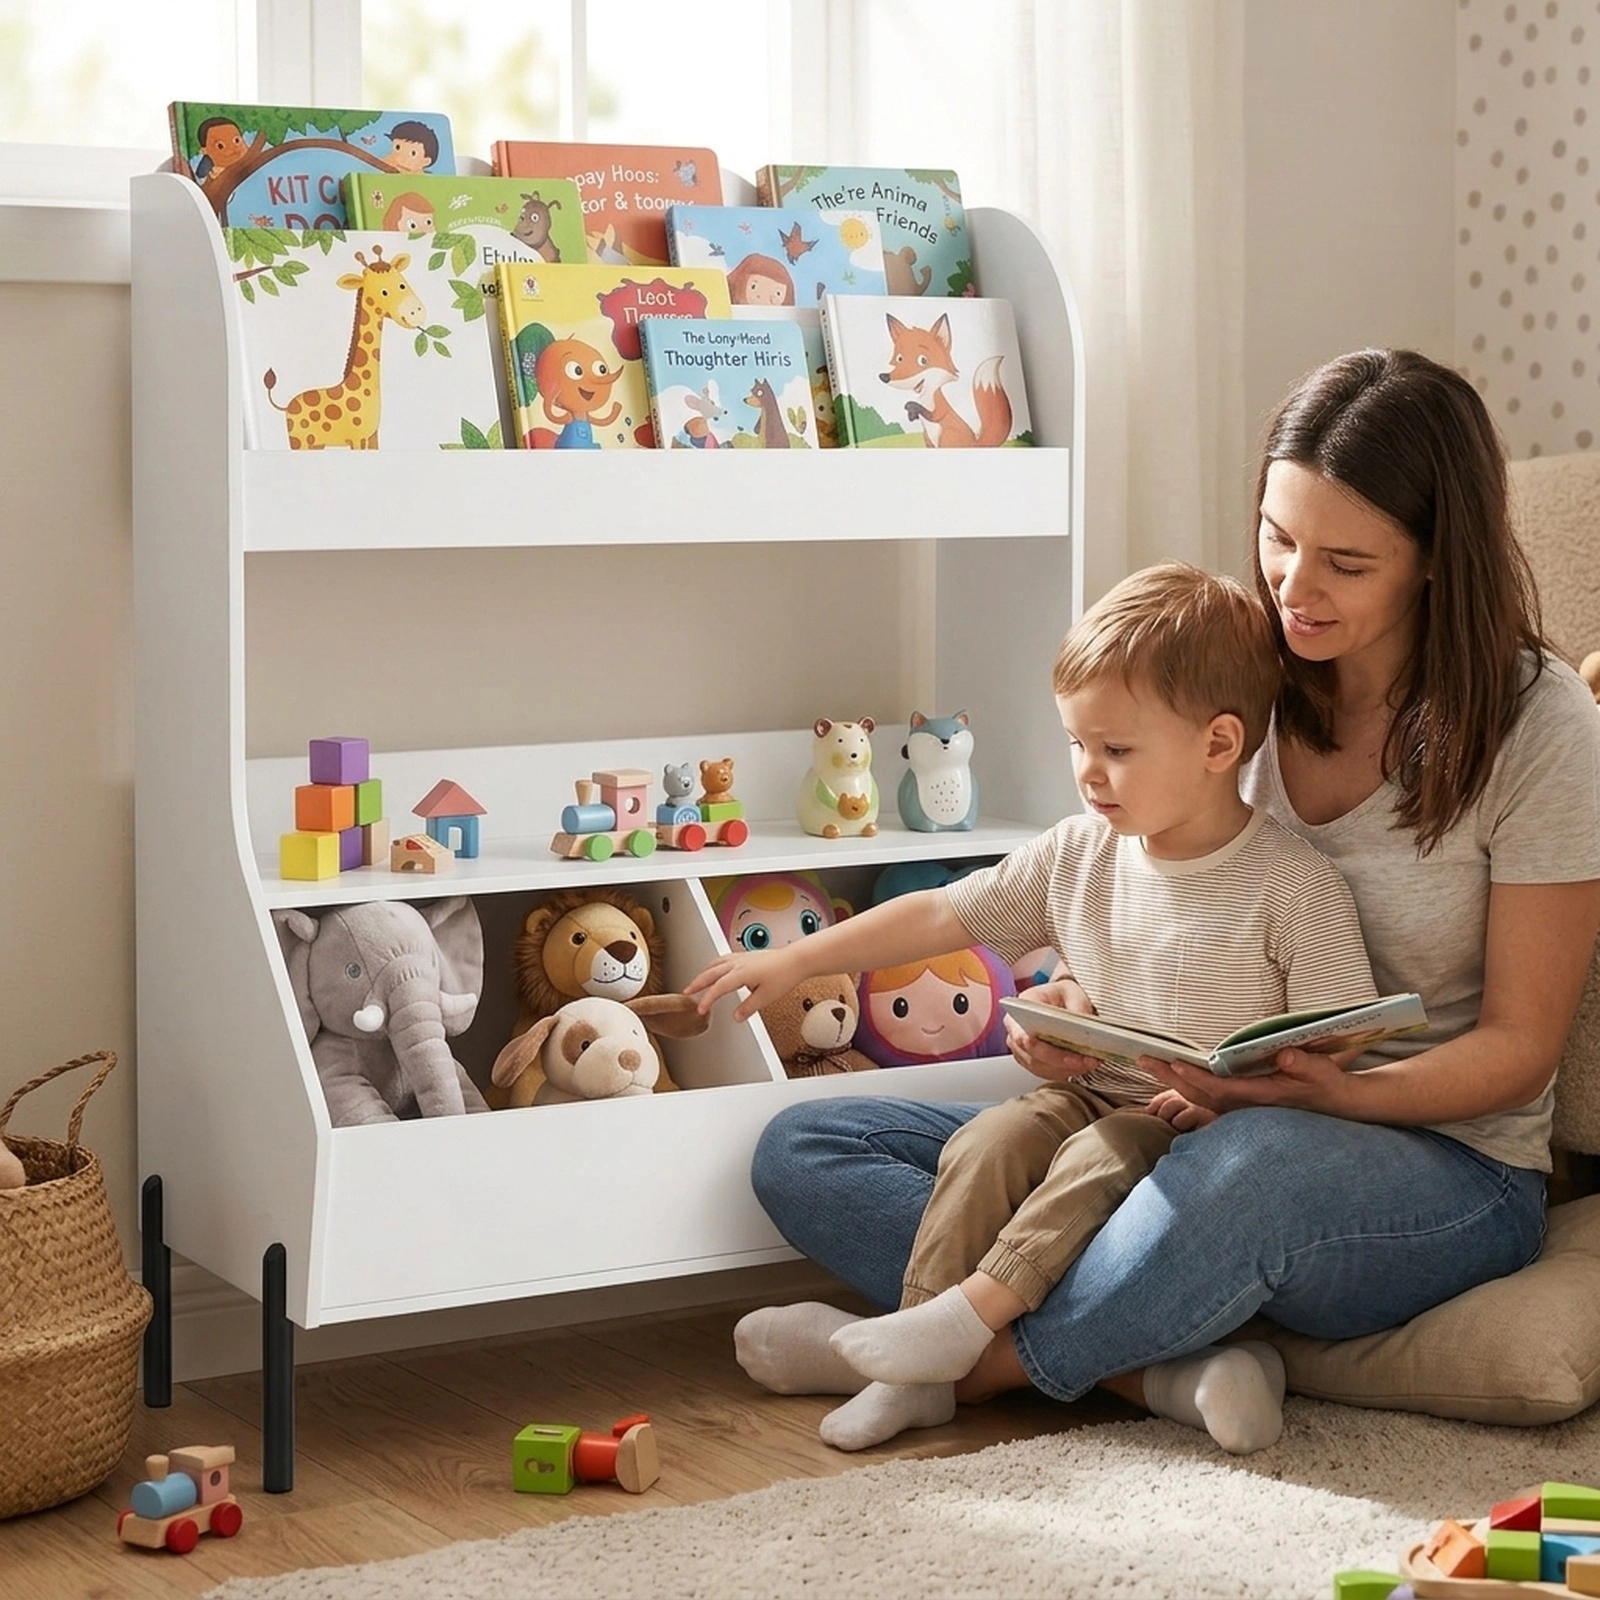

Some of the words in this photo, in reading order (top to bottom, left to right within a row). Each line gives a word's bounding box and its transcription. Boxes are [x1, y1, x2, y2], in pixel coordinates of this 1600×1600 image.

[565, 170, 605, 192] pay
[611, 164, 659, 184] Hoos:
[267, 174, 309, 206] KIT
[318, 174, 346, 207] C
[614, 191, 628, 210] &
[811, 186, 865, 211] The're
[871, 182, 928, 212] Anima
[875, 207, 938, 245] Friends
[637, 288, 676, 306] Leot
[682, 331, 706, 343] The
[664, 350, 748, 371] Thoughter
[754, 351, 792, 367] Hiris
